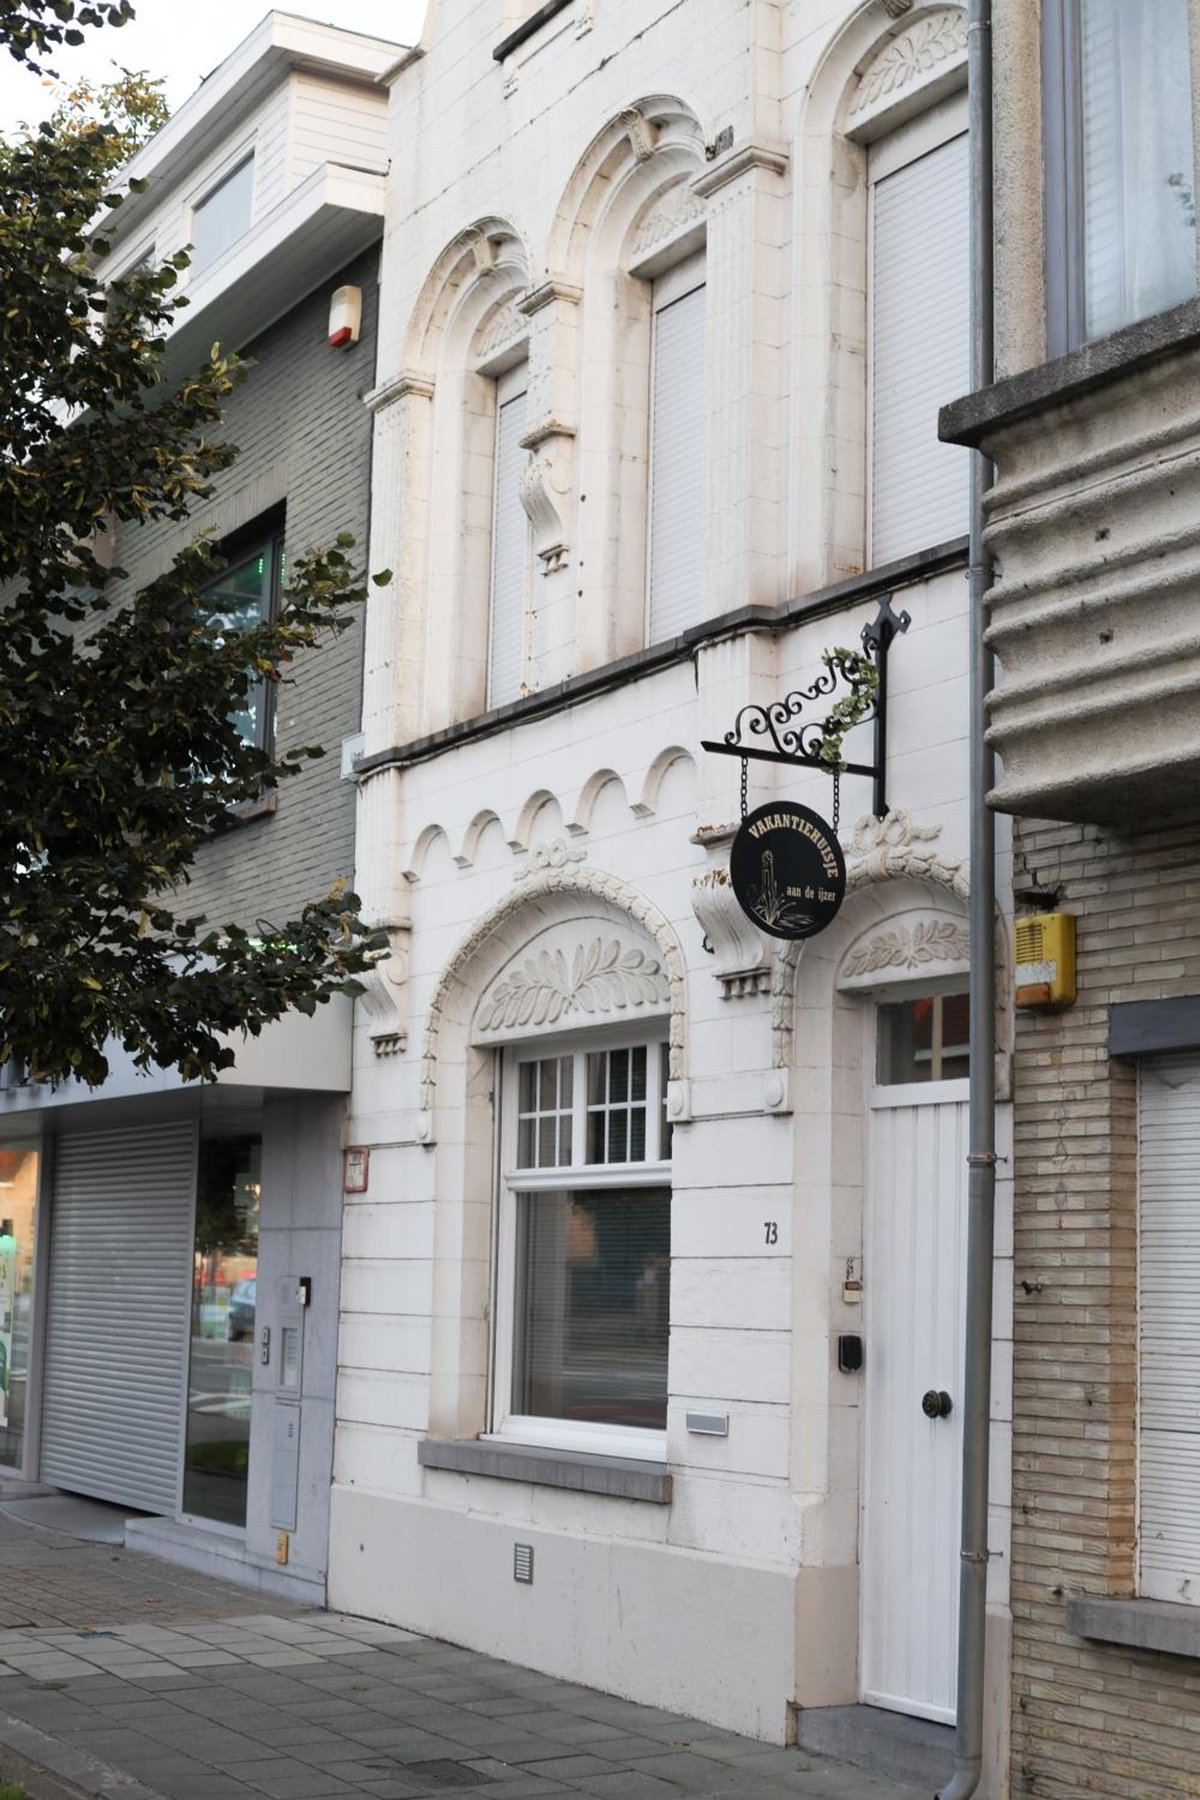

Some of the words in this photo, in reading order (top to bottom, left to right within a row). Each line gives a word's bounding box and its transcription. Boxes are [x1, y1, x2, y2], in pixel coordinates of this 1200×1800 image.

[748, 814, 839, 878] VAKANTIEHUISJE
[787, 886, 802, 898] aan
[805, 886, 815, 899] de
[764, 1222, 778, 1244] 73
